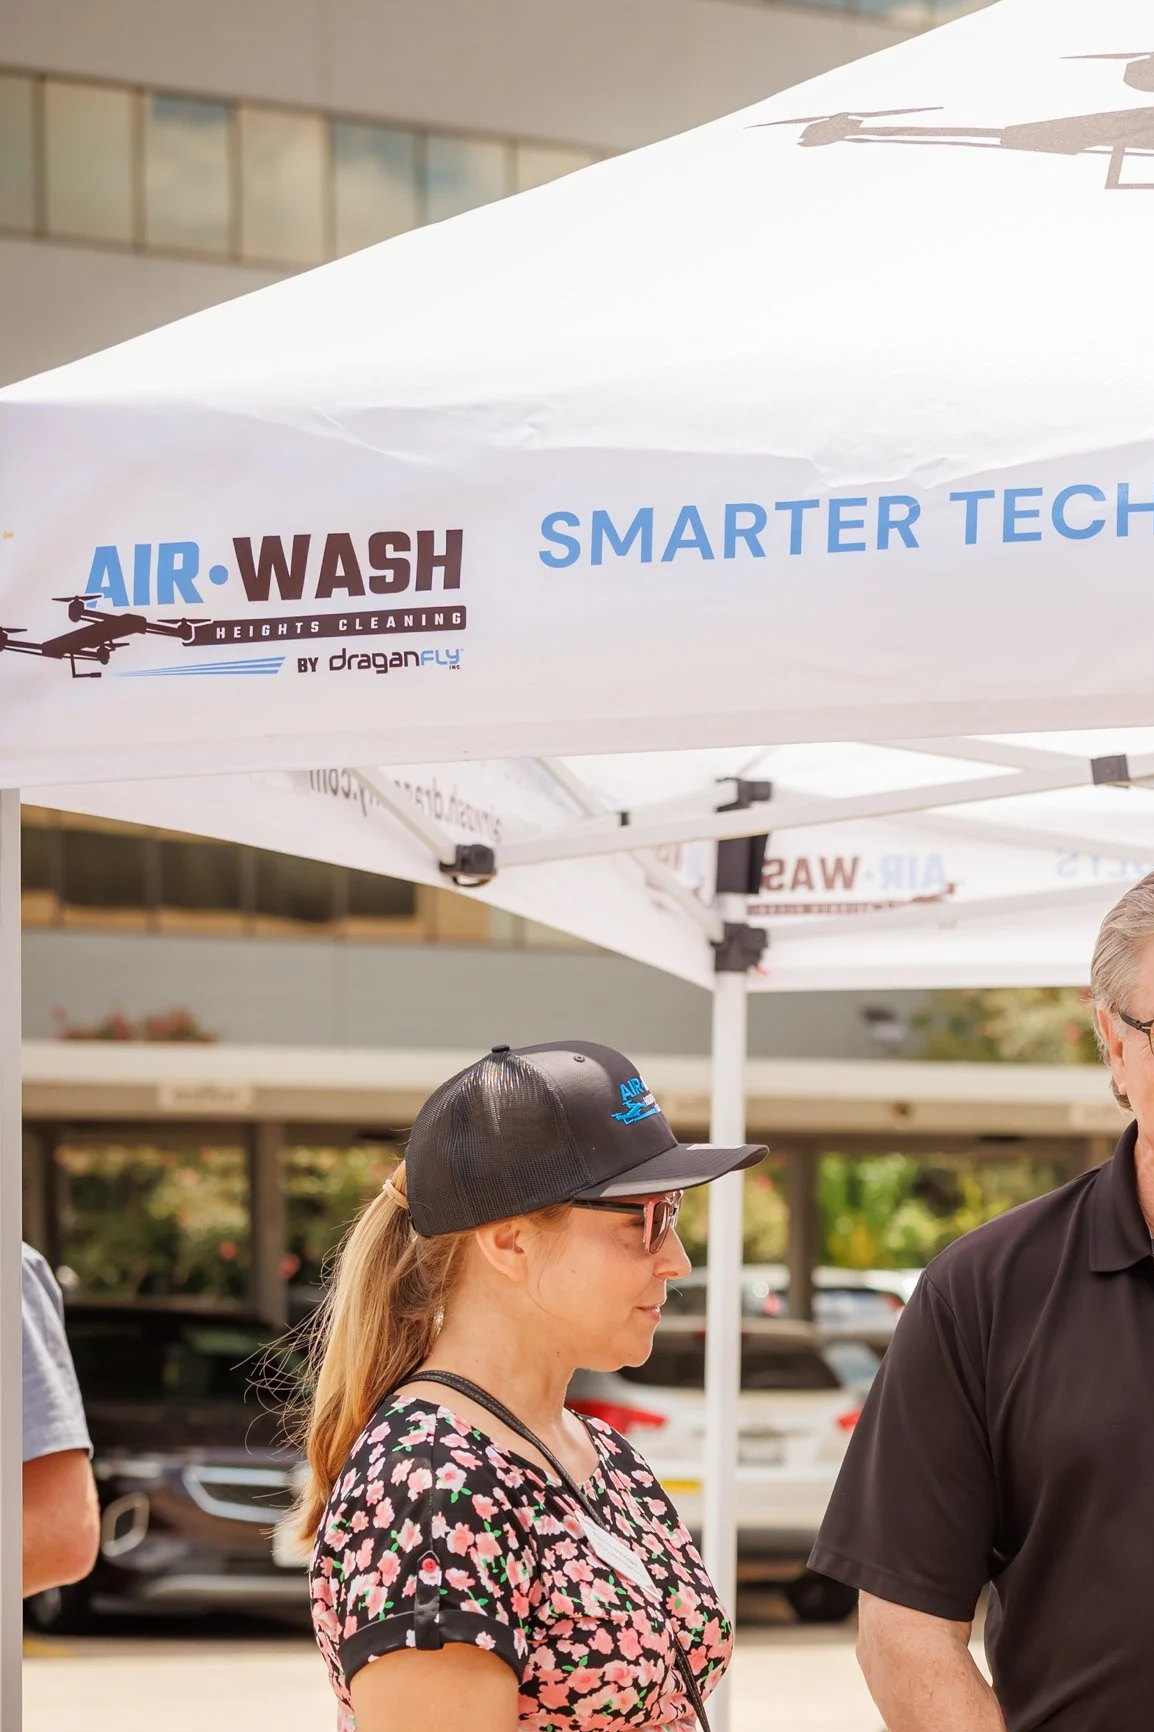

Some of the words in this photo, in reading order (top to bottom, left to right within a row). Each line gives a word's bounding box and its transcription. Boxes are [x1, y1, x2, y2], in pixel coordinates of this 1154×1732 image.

[538, 495, 922, 569] SMARTER
[215, 621, 320, 640] HEIGHTS
[338, 611, 462, 631] CLEANING
[297, 656, 319, 674] BY
